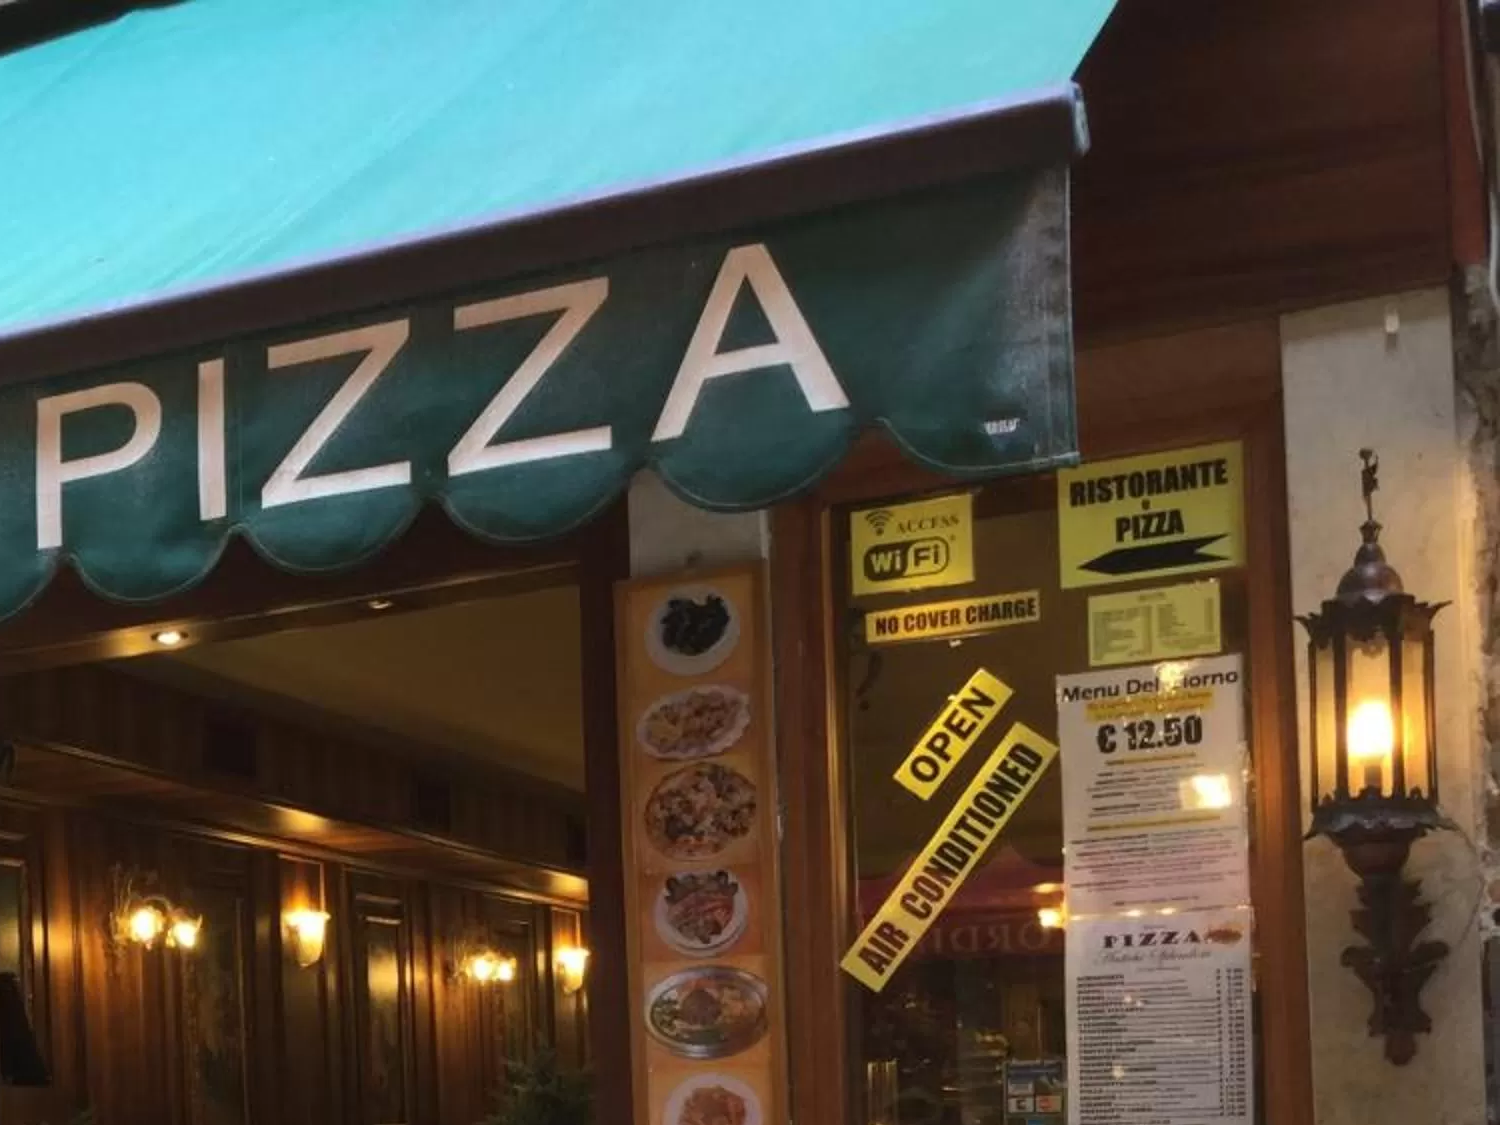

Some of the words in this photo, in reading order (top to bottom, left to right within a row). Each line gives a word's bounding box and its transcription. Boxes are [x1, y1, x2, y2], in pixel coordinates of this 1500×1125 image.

[37, 242, 849, 550] PIZZA
[1070, 459, 1228, 508] RISTORANTE
[897, 513, 960, 535] ACCESS
[1116, 509, 1184, 543] PIZZA
[875, 615, 899, 636] NO
[903, 607, 961, 634] COVER
[965, 598, 1037, 625] CHARGE
[1061, 684, 1120, 703] Menu
[1126, 679, 1159, 694] Del
[910, 687, 996, 784] OPEN
[1123, 715, 1203, 751] 12.50
[858, 921, 911, 978] AIR
[901, 743, 1045, 921] CONDITIONED
[1103, 930, 1201, 948] PIZZA
